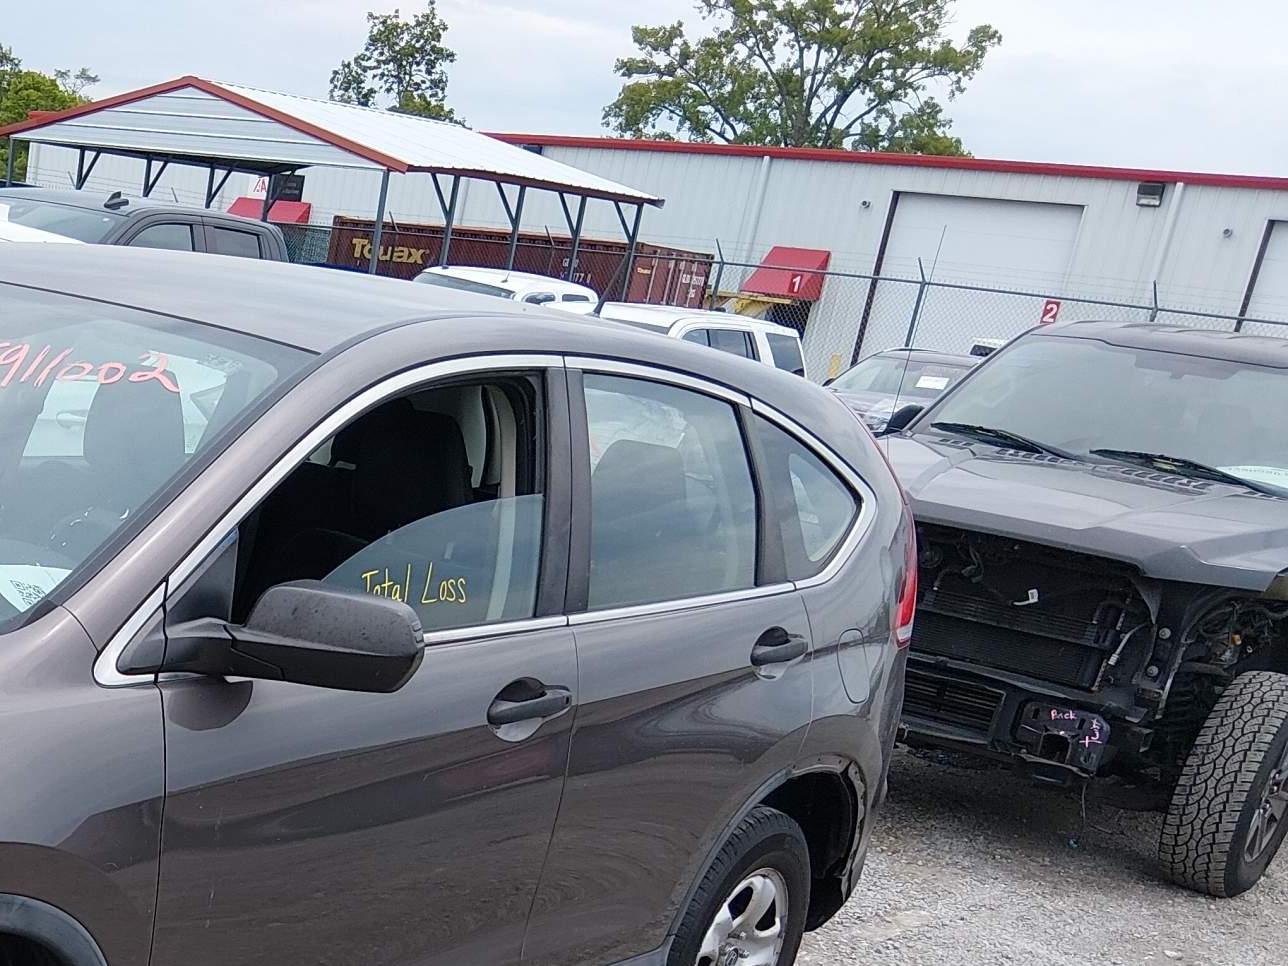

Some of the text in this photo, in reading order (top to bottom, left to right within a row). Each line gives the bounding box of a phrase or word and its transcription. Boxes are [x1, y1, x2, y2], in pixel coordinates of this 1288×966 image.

[792, 275, 802, 293] 1
[1042, 303, 1058, 323] 2
[421, 561, 466, 604] Loss
